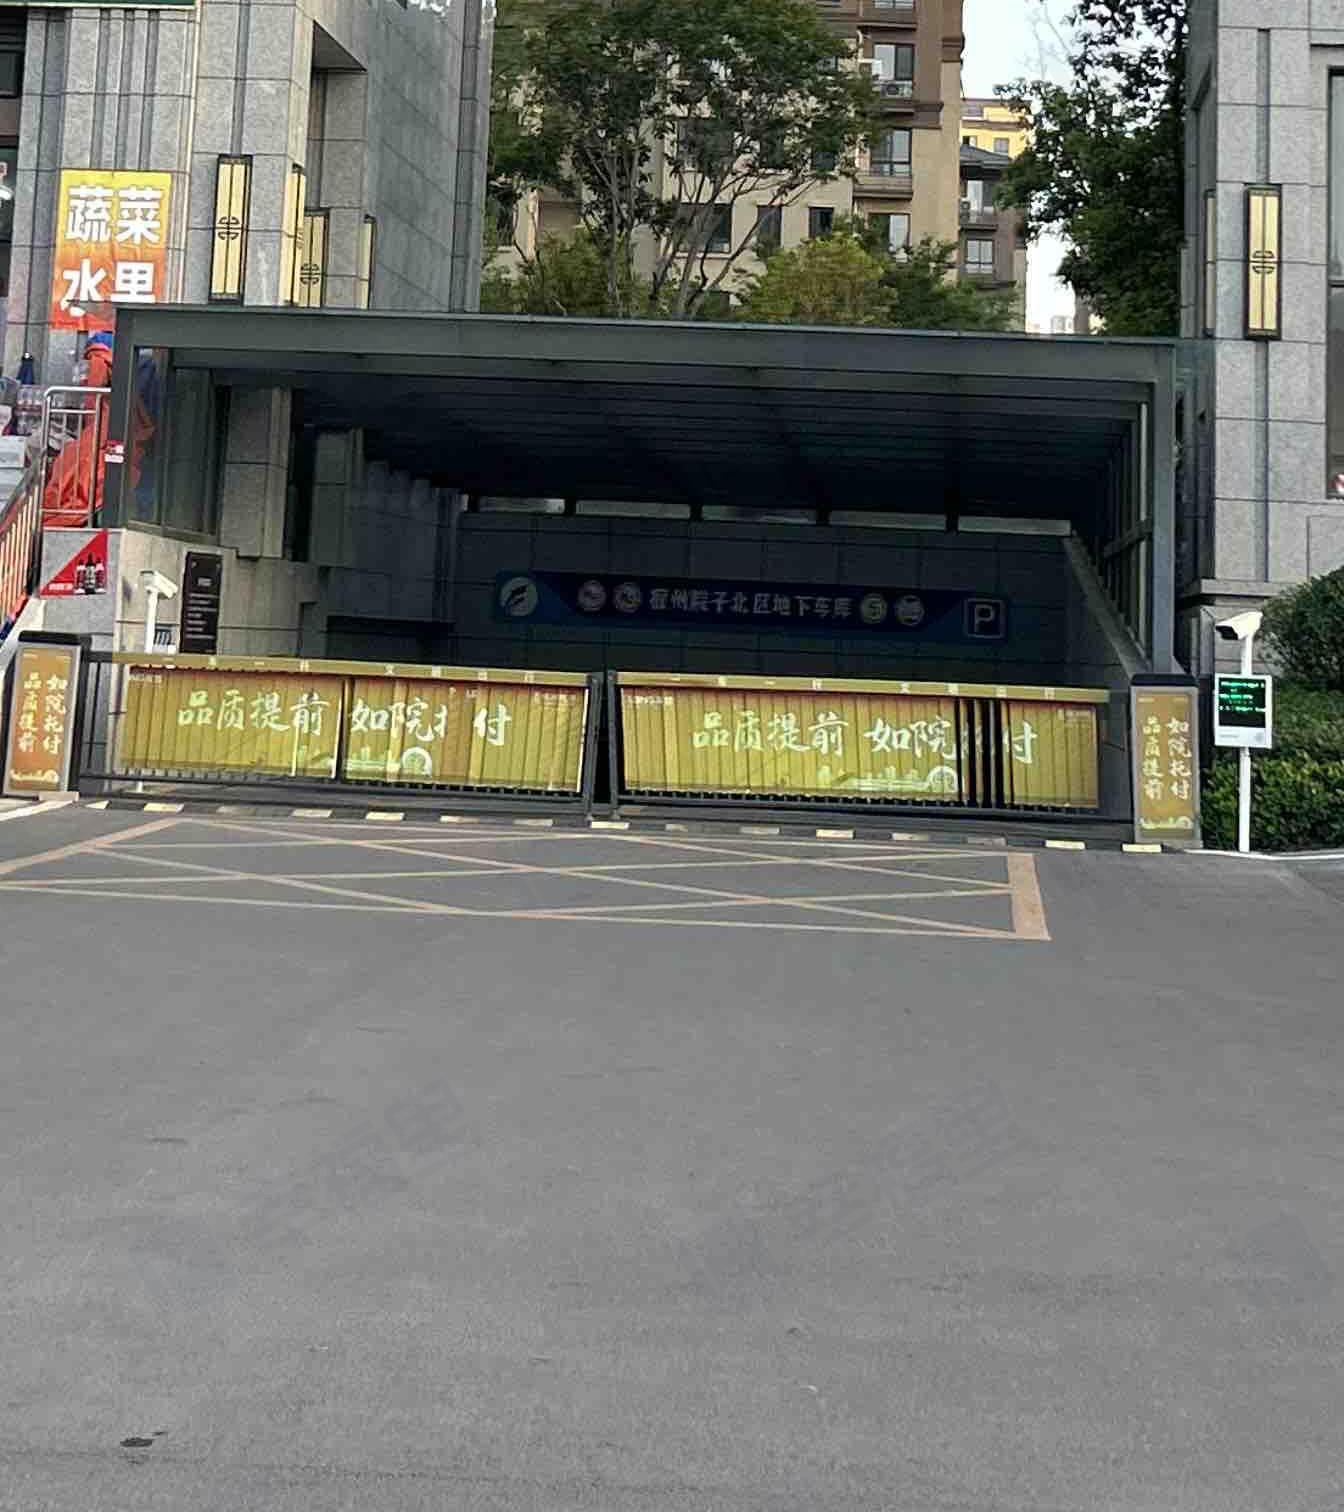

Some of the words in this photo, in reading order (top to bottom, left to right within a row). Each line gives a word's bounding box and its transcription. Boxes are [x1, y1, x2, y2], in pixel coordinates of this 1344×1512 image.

[64, 185, 163, 245] 蔬菜
[176, 689, 330, 736] 品质提前
[693, 711, 849, 757] 品质提前
[863, 714, 1038, 764] 如院付
